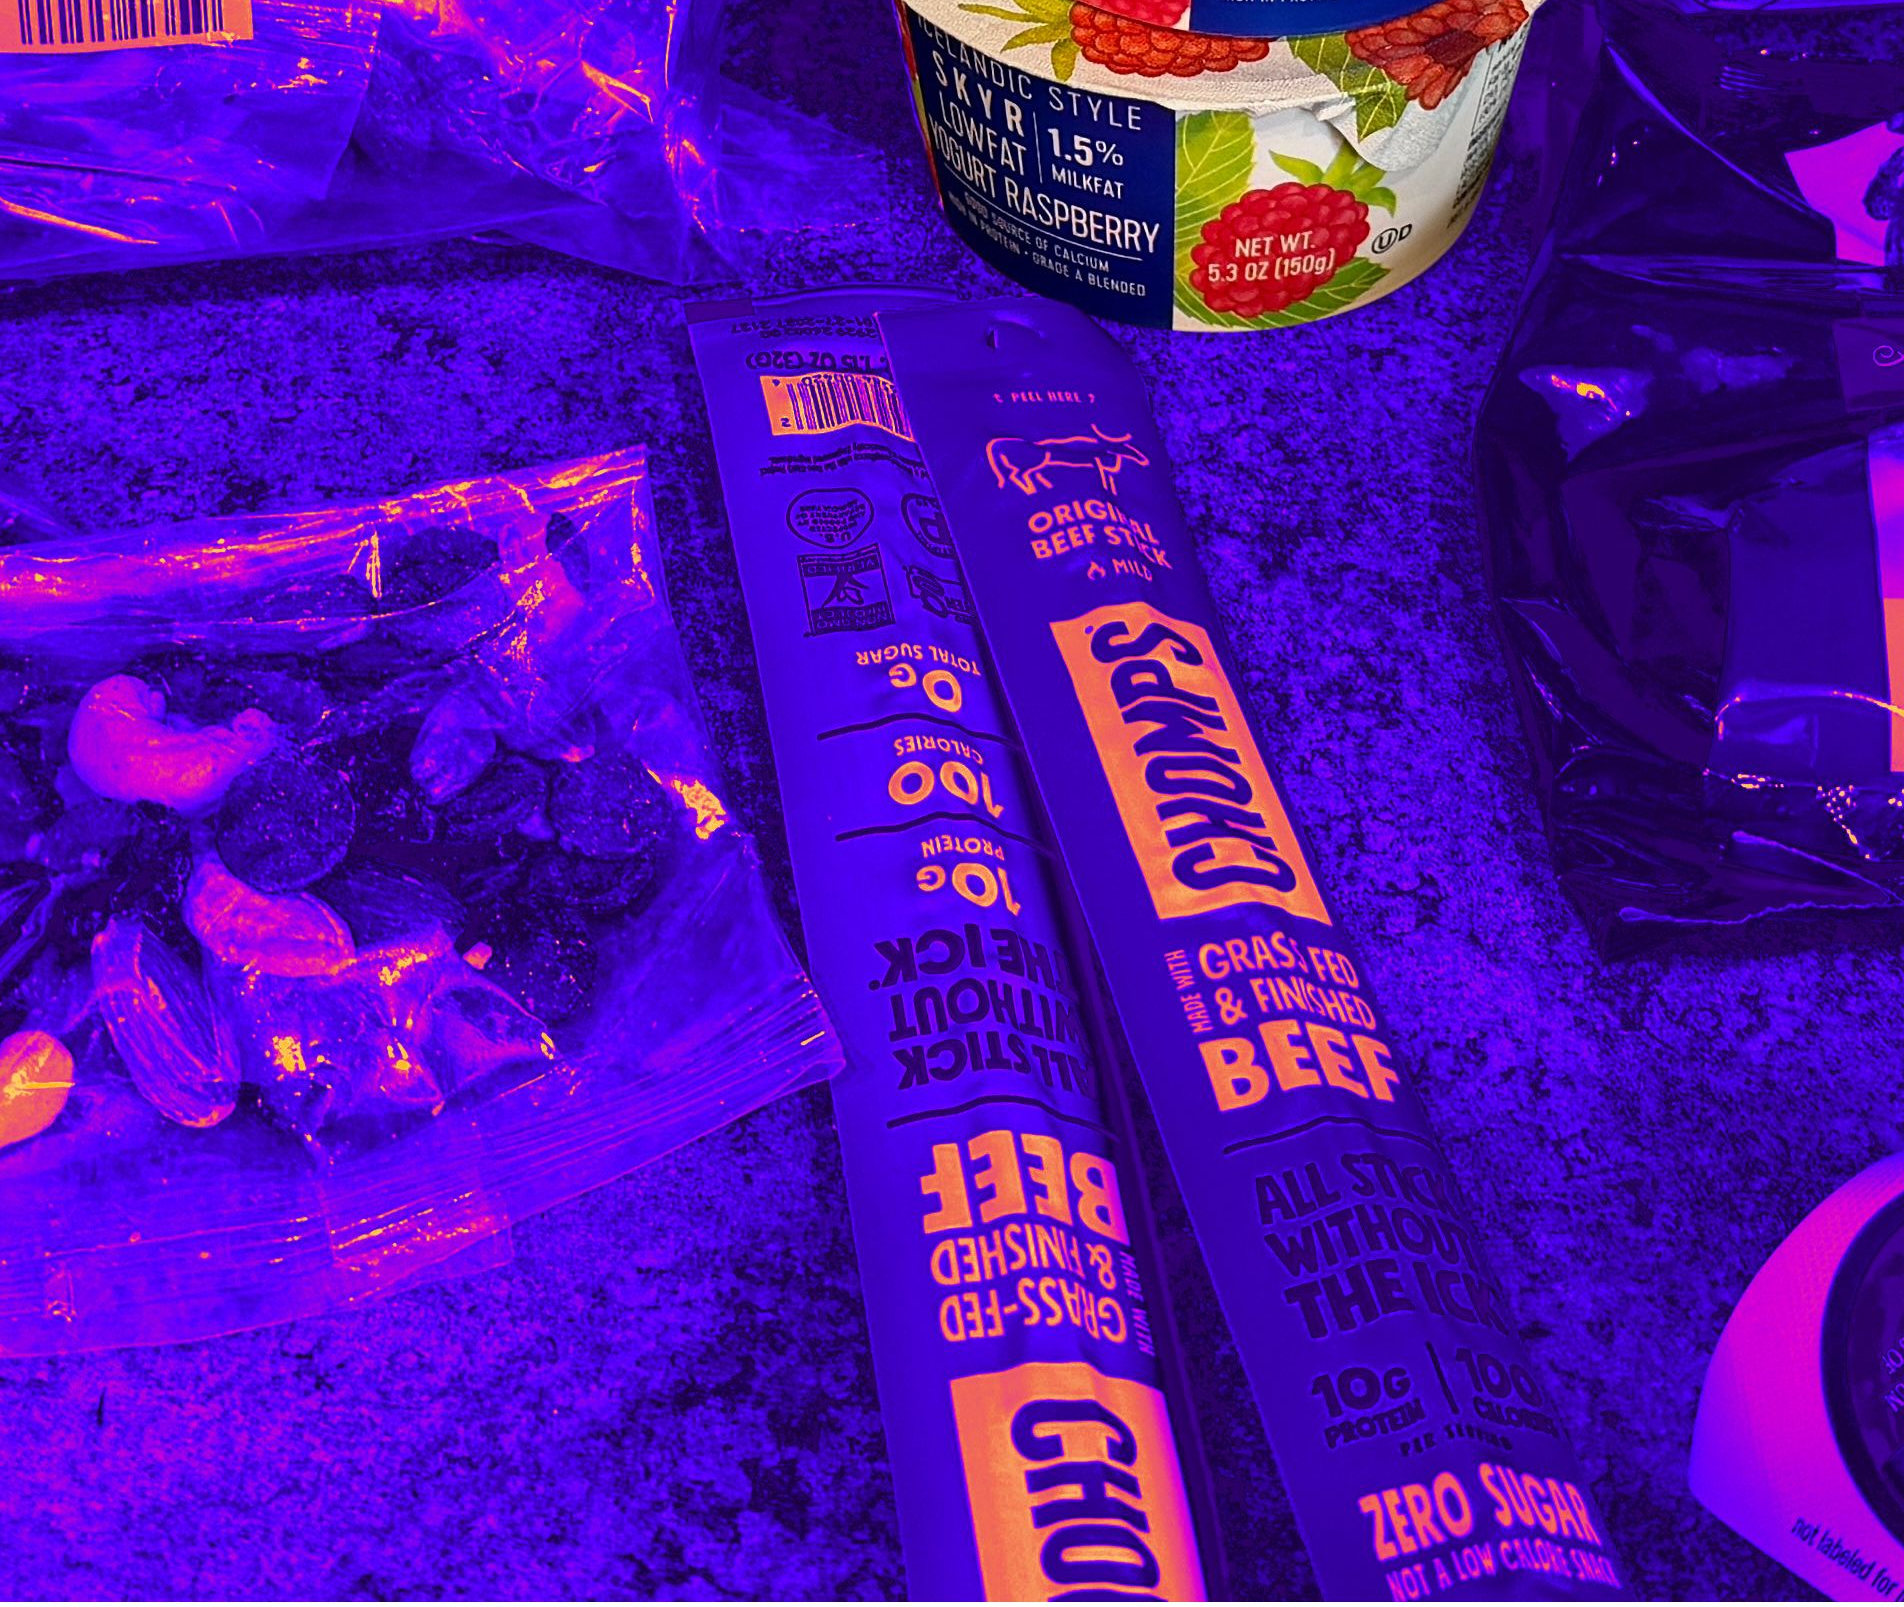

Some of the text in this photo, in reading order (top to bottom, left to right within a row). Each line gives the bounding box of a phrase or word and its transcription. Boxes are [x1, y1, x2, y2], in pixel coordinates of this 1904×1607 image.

[939, 90, 1028, 176] LOWFAT
[1048, 86, 1142, 131] STYLE
[1047, 128, 1125, 168] 1.5%
[929, 112, 1160, 254] YOGURT RASPBERRY
[1051, 163, 1125, 200] MILKFAT
[1054, 244, 1110, 273] CALCIUM
[1208, 250, 1337, 283] 5.3 OZ (150g)
[1235, 236, 1274, 258] NET
[1088, 272, 1147, 298] BLENDED
[1030, 523, 1098, 561] BEEF
[1112, 557, 1154, 583] MILD
[855, 642, 924, 668] SUGAR
[892, 733, 985, 766] CALORIES
[1091, 620, 1297, 892] CHOMPS
[887, 759, 1005, 821] 100
[919, 833, 1007, 863] PROTEIN
[1197, 929, 1361, 991] GRASS FED
[889, 976, 1087, 1043] WITHOUT
[1213, 974, 1378, 1033] & FINISHED
[896, 1030, 1030, 1091] STICK
[1197, 1017, 1401, 1114] BEEF
[919, 1128, 1132, 1248] BEEF
[1254, 1161, 1342, 1226] ALL
[927, 1220, 1119, 1293] & FINISHED
[1263, 1202, 1482, 1278] WITHOUT
[936, 1275, 1130, 1346] GRASS-FED
[1283, 1256, 1416, 1340] THE
[1323, 1397, 1427, 1450] PROTEIN
[1356, 1461, 1603, 1562] ZERO SUGAR
